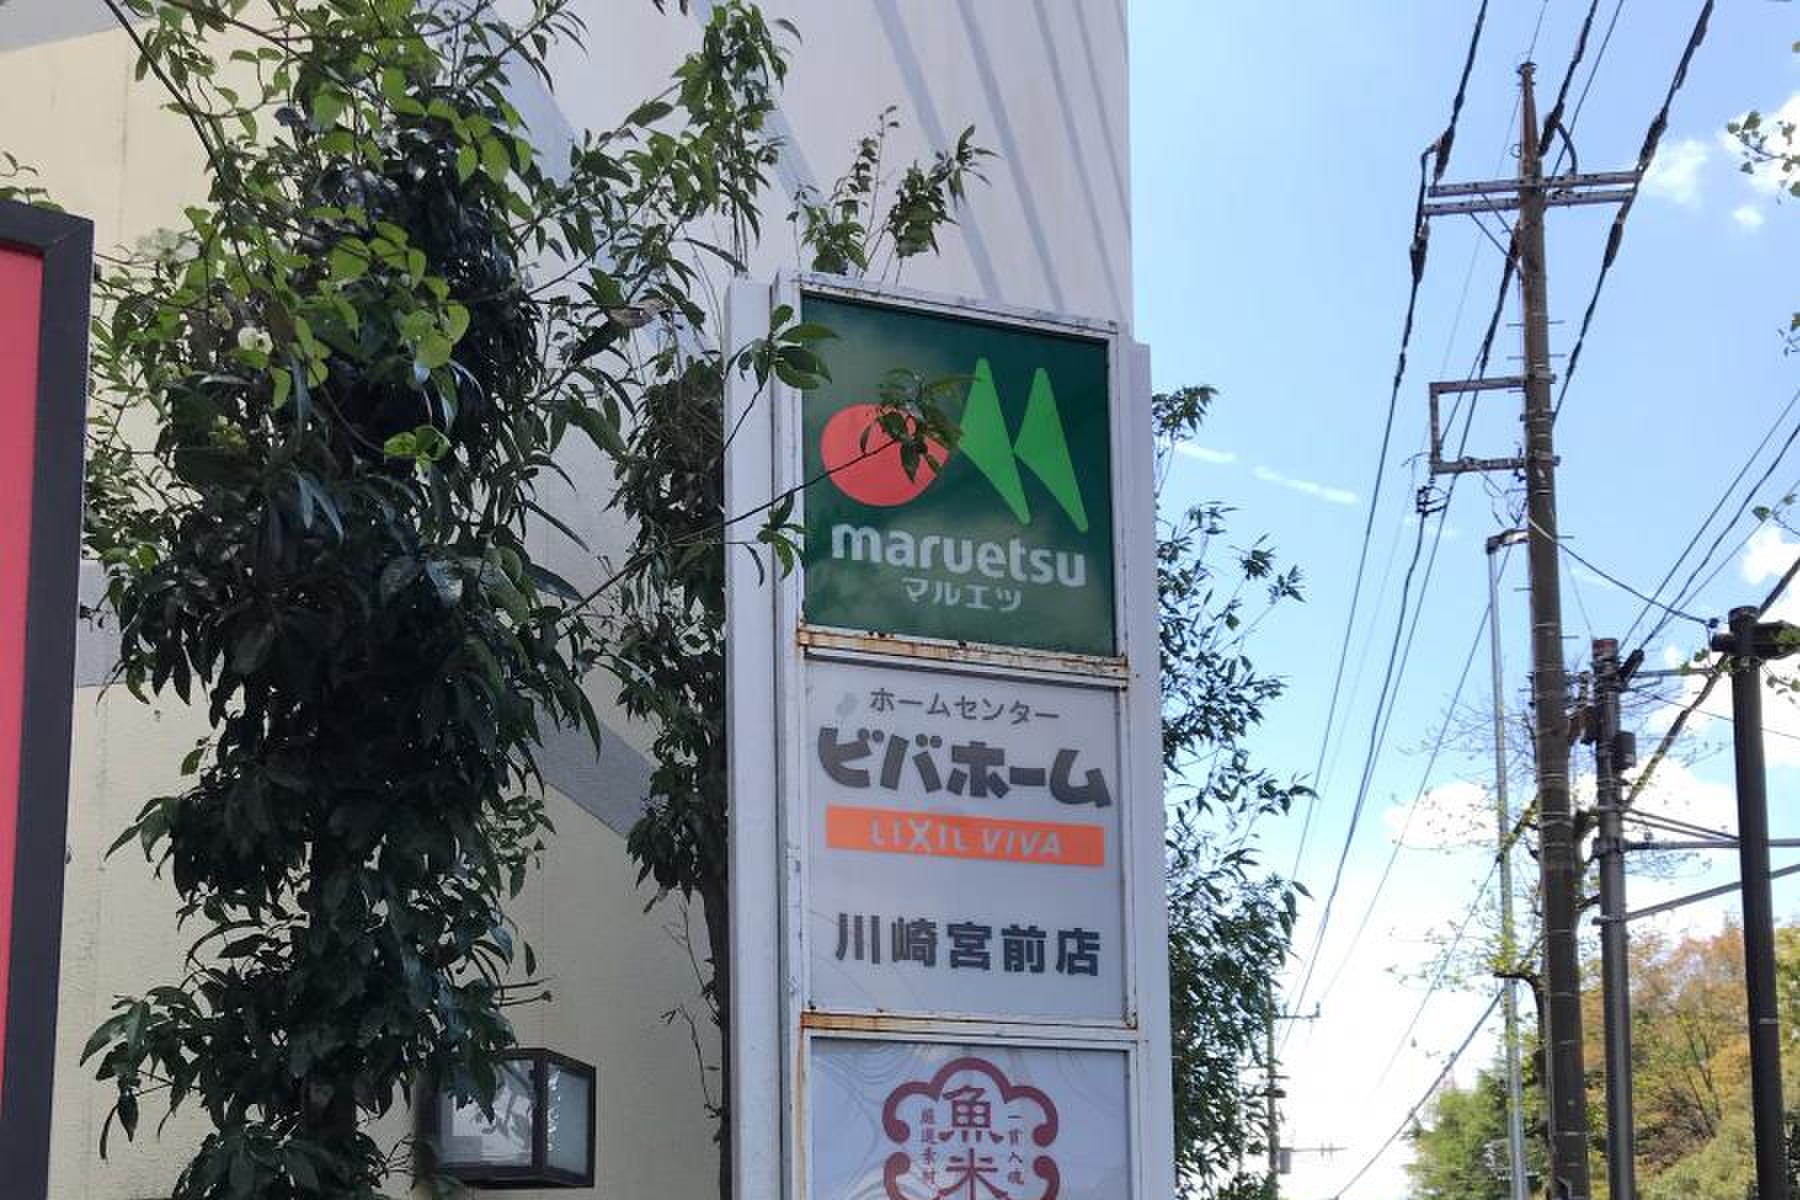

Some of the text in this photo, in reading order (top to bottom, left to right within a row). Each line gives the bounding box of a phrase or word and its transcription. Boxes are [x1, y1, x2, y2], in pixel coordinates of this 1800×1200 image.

[831, 523, 1087, 588] maruetsu
[902, 577, 1023, 612] マルエツ
[869, 687, 1060, 725] ホームセンター
[817, 726, 1112, 808] ビバホーム
[868, 817, 1064, 857] LIXIL VIVA
[835, 912, 1101, 977] 川崎宮前店
